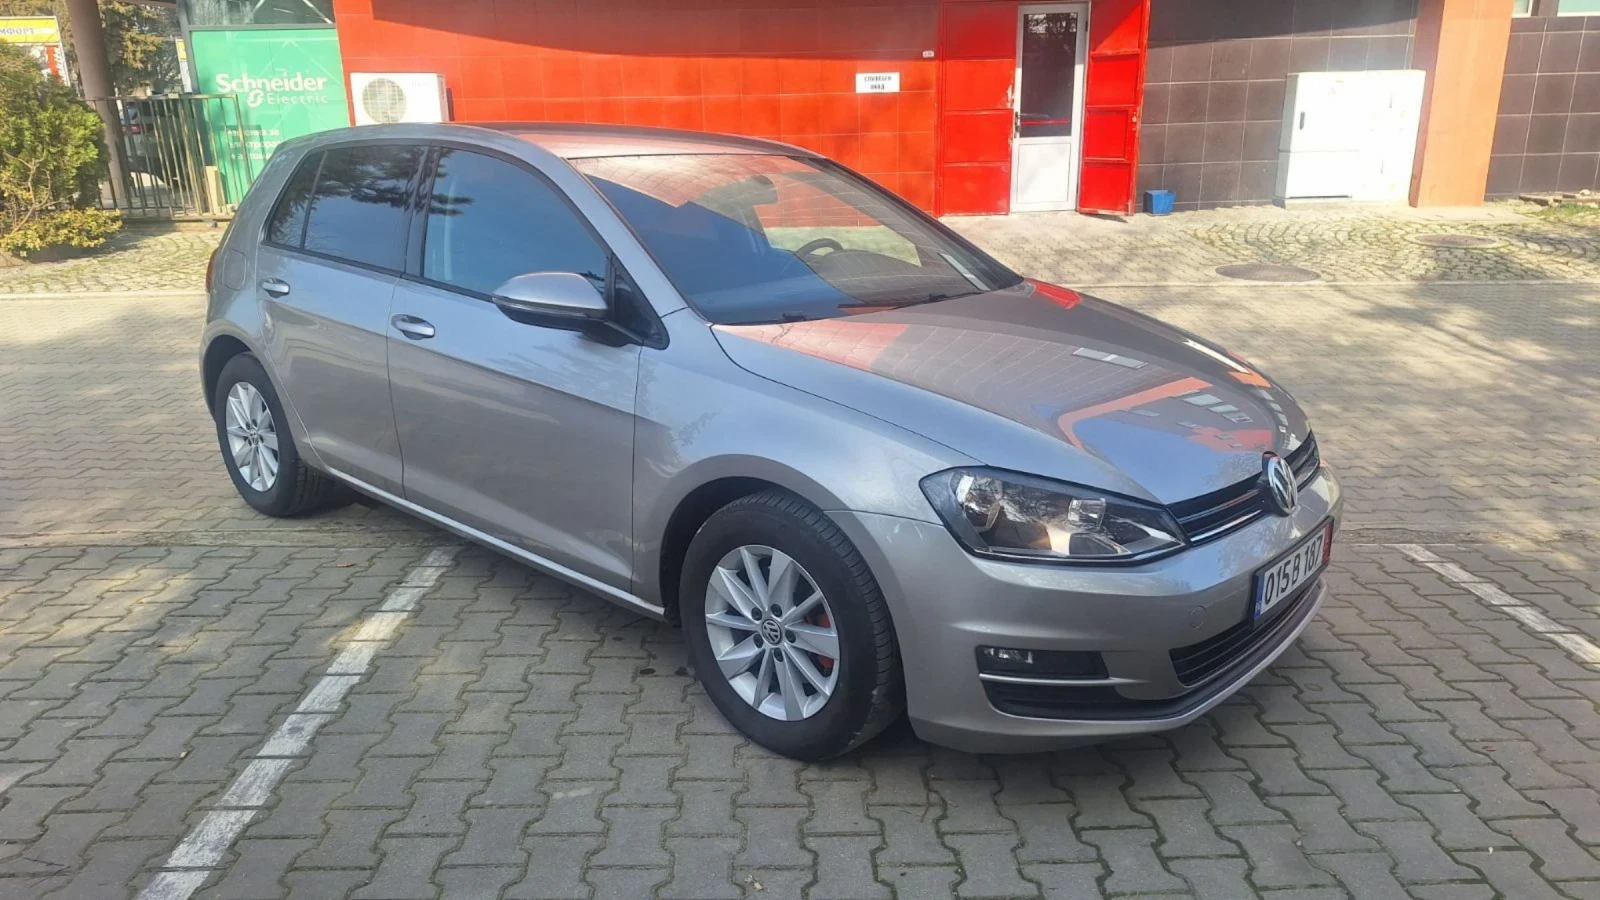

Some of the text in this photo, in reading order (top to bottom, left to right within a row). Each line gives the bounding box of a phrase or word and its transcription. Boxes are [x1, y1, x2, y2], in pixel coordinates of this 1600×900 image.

[216, 72, 327, 93] Schneider
[267, 94, 328, 104] Electric
[1264, 552, 1300, 606] 015B
[1303, 533, 1324, 577] 187
